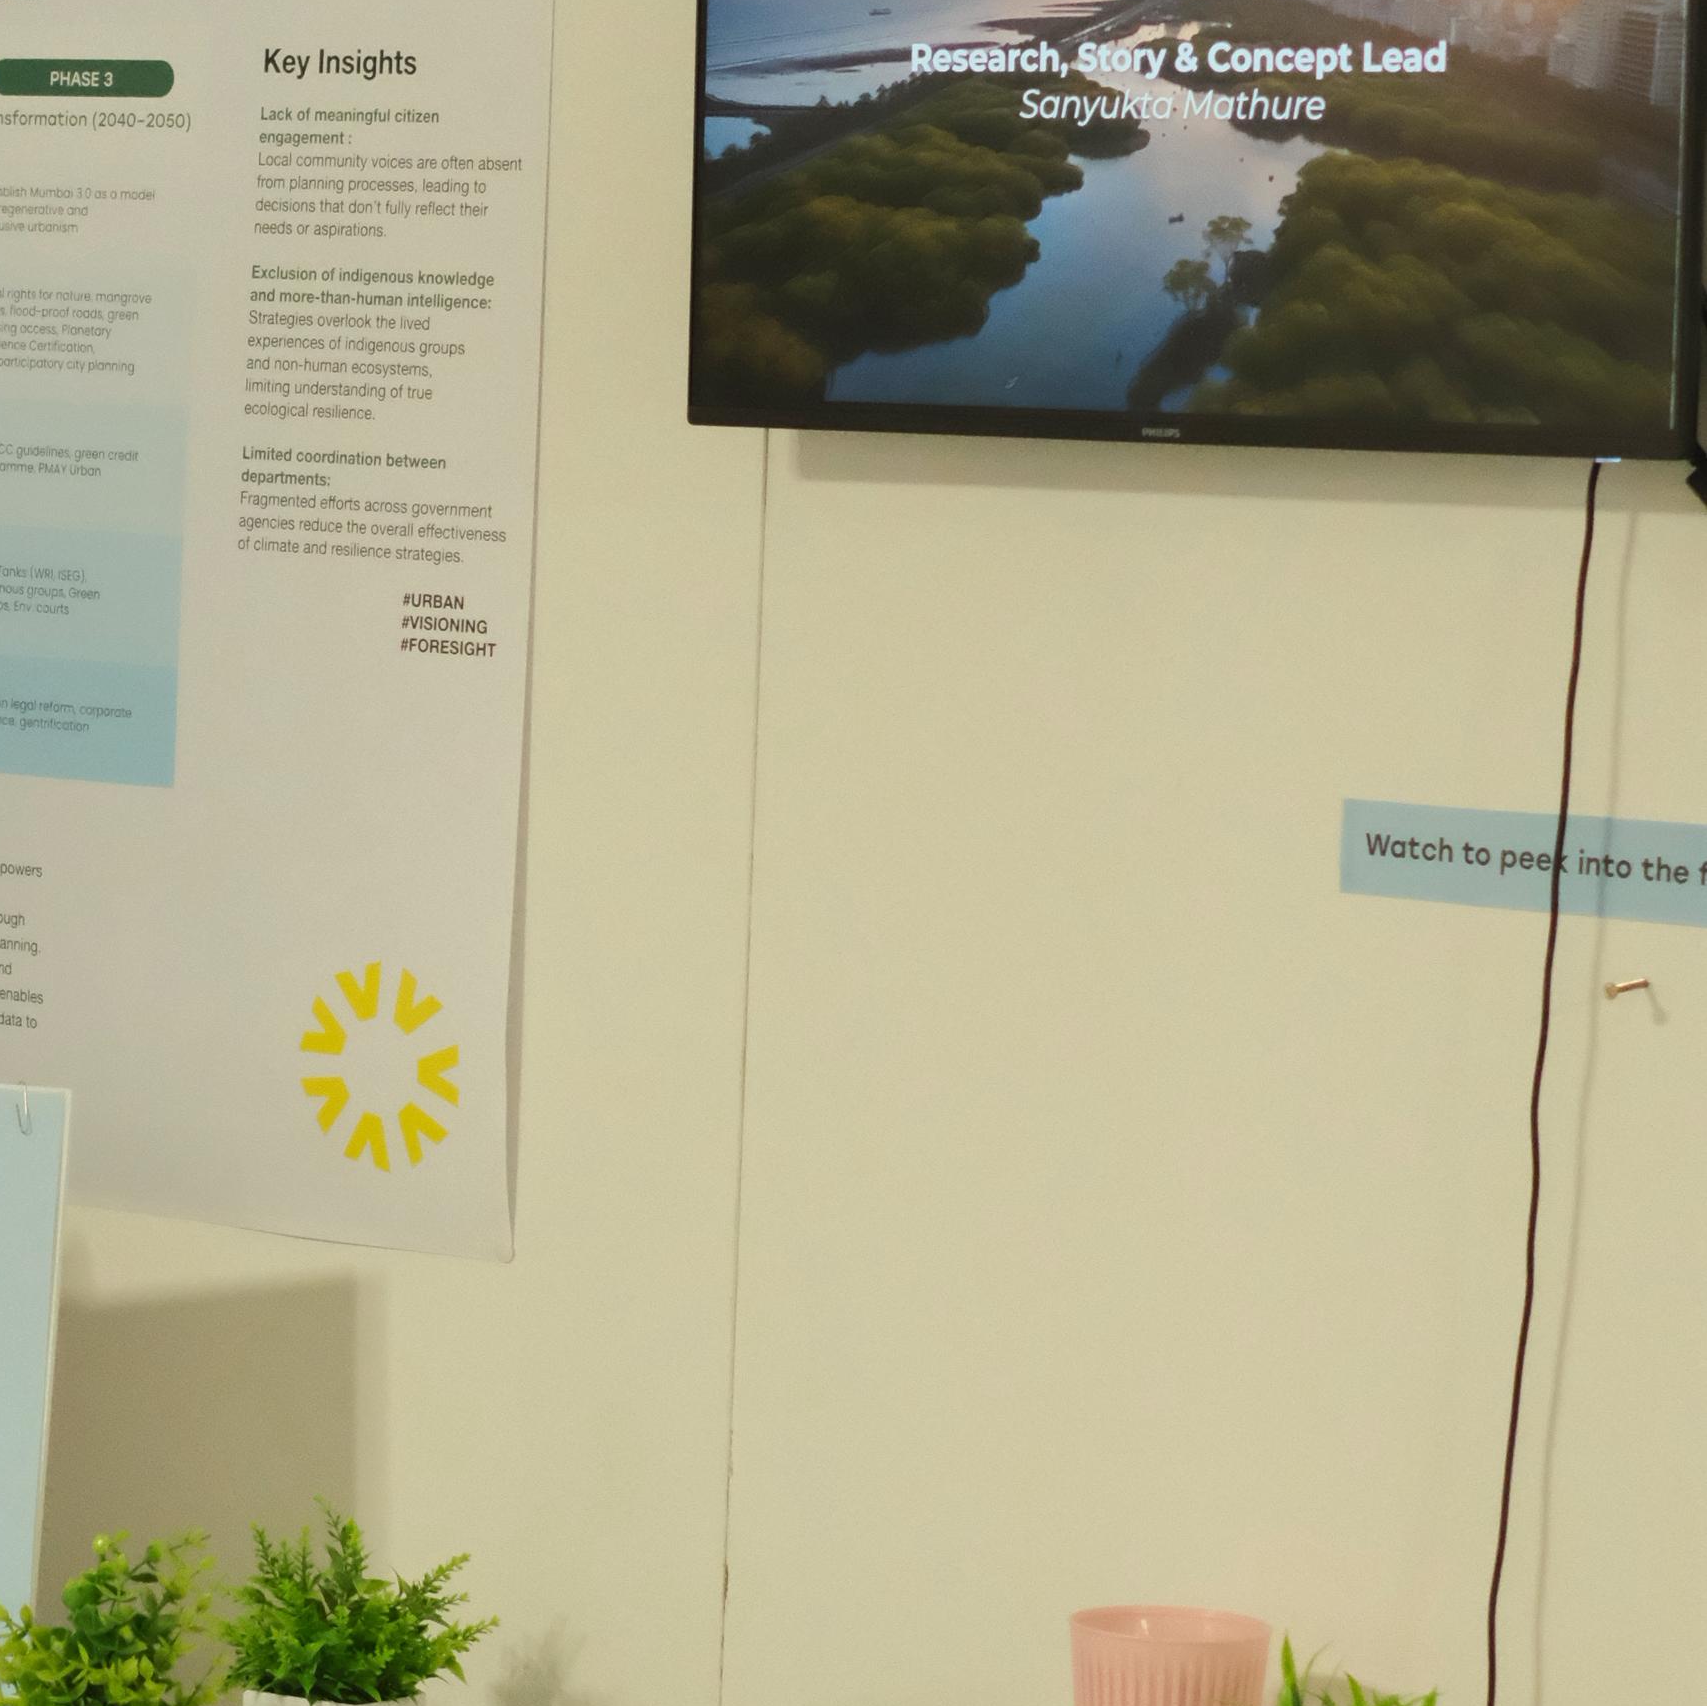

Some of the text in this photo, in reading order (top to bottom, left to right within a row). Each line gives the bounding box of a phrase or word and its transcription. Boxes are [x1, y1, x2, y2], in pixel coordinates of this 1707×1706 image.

[263, 48, 416, 80] Key Insights
[911, 41, 1447, 79] Research, Story & Concept Lead
[49, 71, 113, 87] PHASE 3
[261, 107, 439, 126] Lack of meaningful citizen
[1020, 89, 1325, 126] Sanyukta Mathure
[259, 131, 344, 147] engagement
[259, 152, 522, 171] Local community voices are often absent
[257, 175, 486, 197] from planning processes, leading to
[251, 264, 494, 289] Exclusion of indigenous knowledge
[249, 288, 491, 312] and more-than-human intelligence:
[1142, 428, 1180, 438] PHILIPS
[243, 446, 446, 469] Limited coordination between
[241, 468, 330, 486] departments:
[241, 490, 492, 519] Fragmented efforts across government
[403, 593, 464, 610] #URBAN
[401, 616, 487, 634] #VISIONING
[401, 637, 496, 657] #FORESIGHT
[1366, 832, 1453, 862] Watch
[1463, 842, 1490, 866] to
[1501, 849, 1567, 875] peek
[1579, 850, 1631, 878] into
[1643, 857, 1689, 884] the
